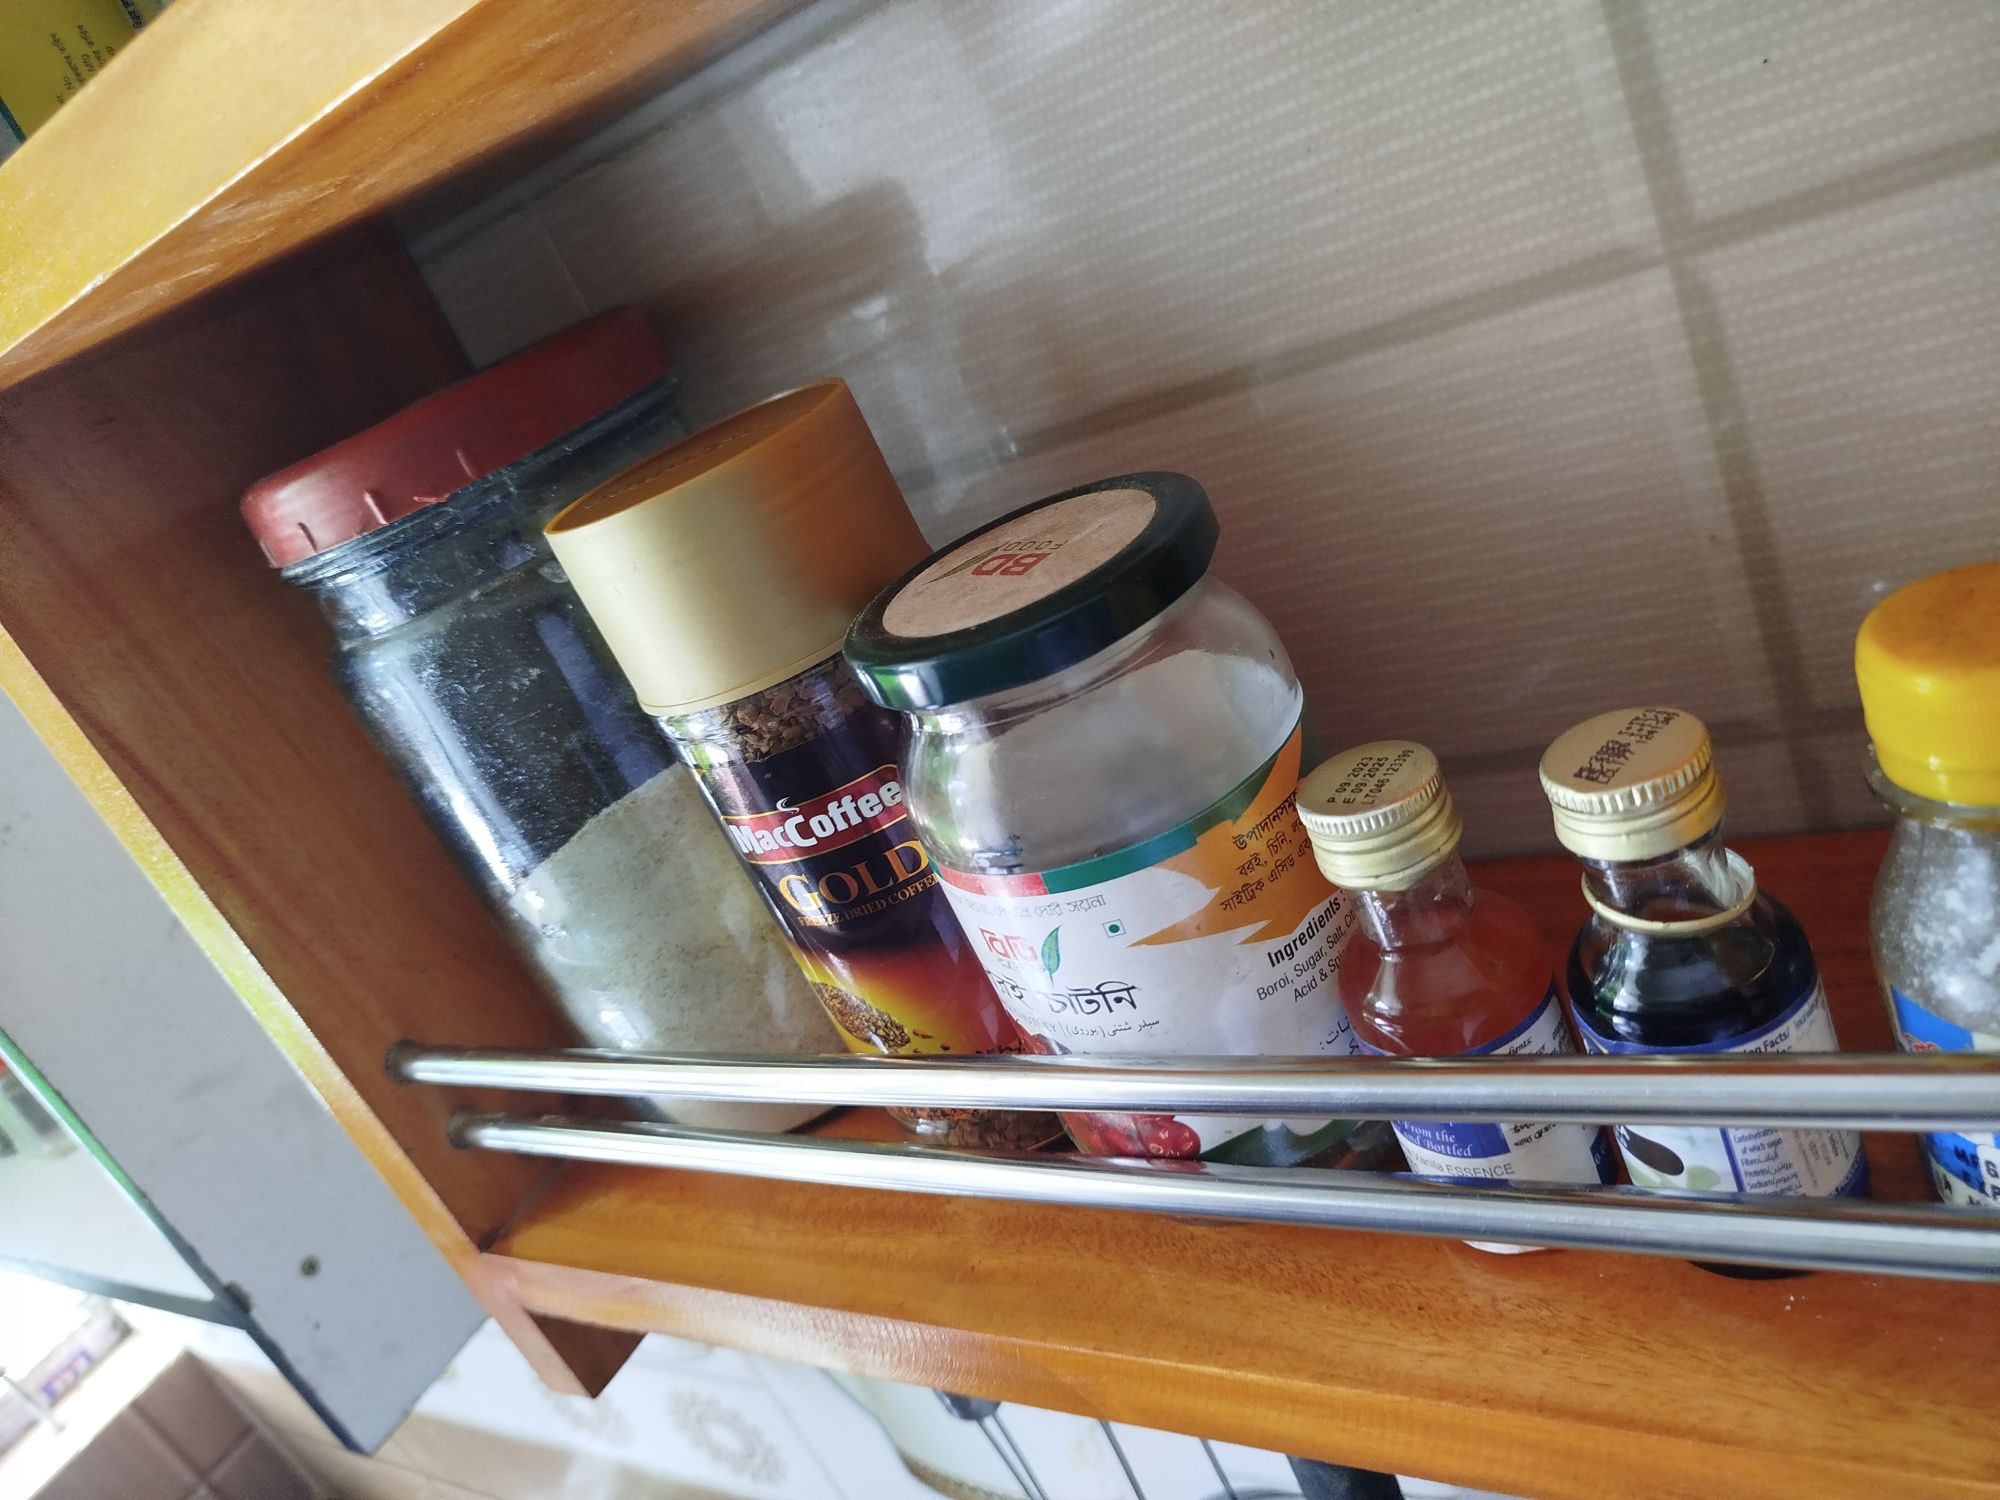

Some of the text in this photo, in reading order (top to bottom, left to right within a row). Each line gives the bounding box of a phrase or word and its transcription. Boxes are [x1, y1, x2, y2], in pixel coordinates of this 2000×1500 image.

[972, 553, 1053, 576] BD
[729, 780, 902, 854] MacCoffee
[779, 840, 930, 912] GOLD
[845, 899, 887, 920] DRIED
[1266, 893, 1342, 968] Ingredients
[1256, 972, 1294, 1001] Boroi,
[1293, 945, 1328, 978] Sugar,
[1293, 976, 1318, 1003] Acid
[1318, 968, 1329, 982] &
[1040, 980, 1139, 1015] চাটনি
[1424, 1139, 1473, 1157] Bottled
[1435, 1129, 1456, 1143] the
